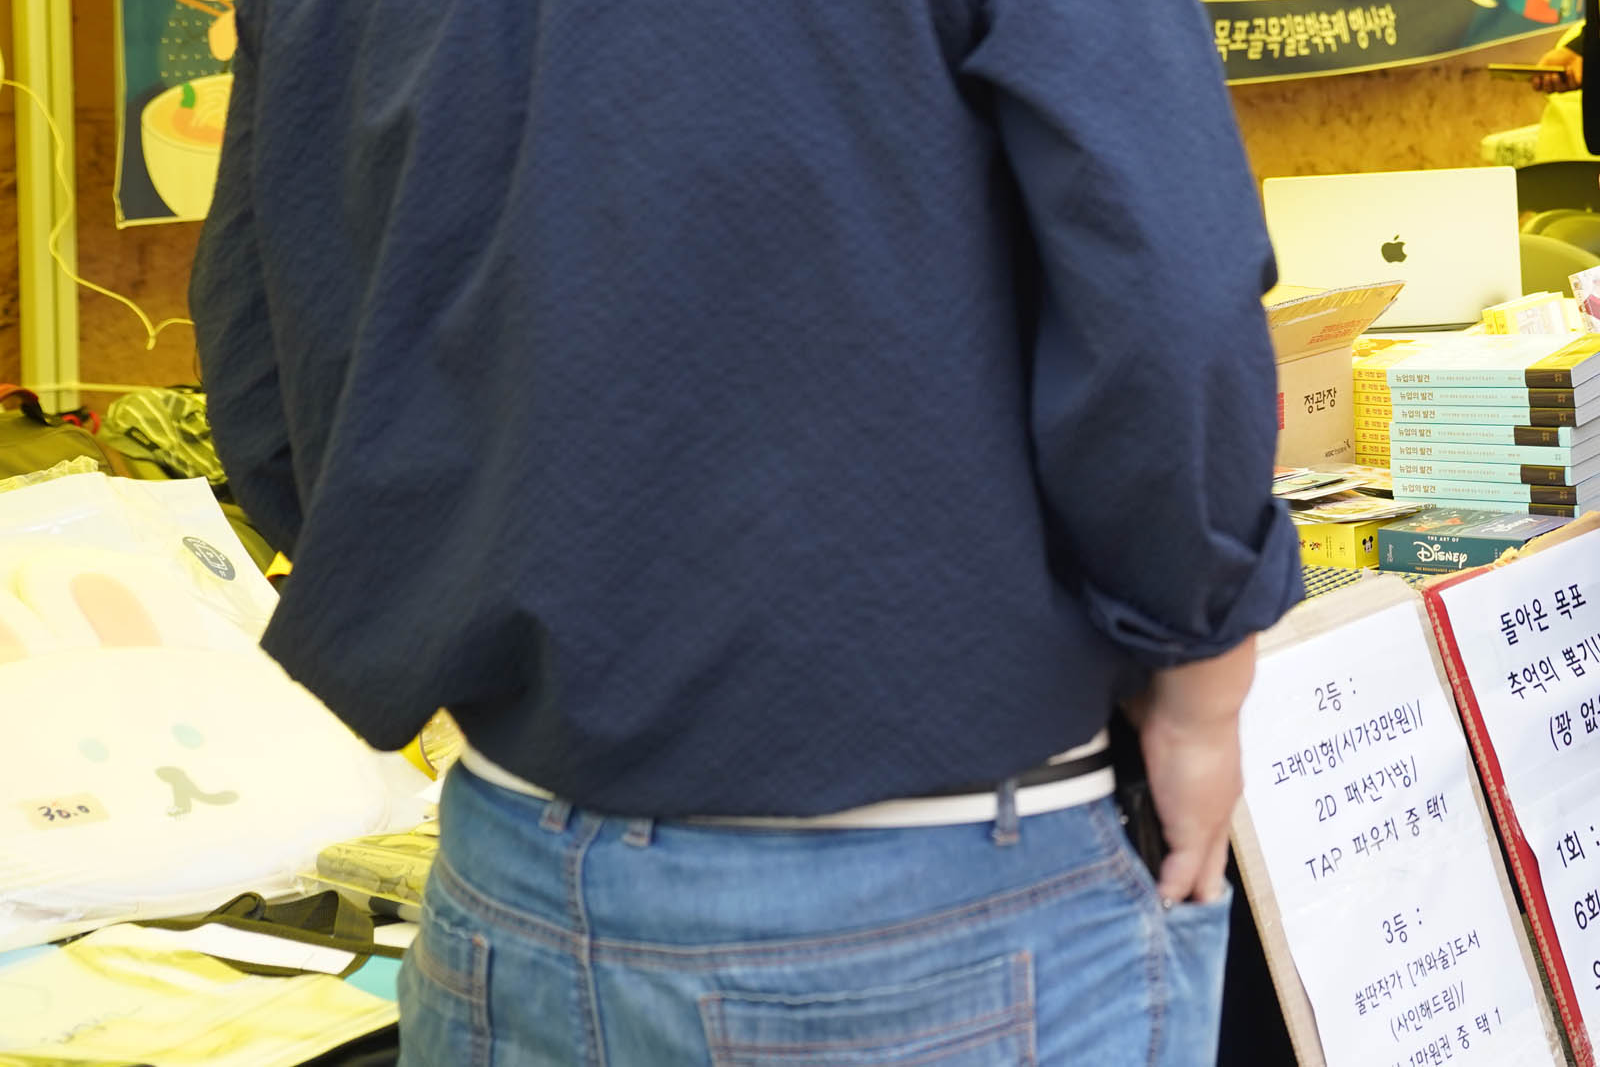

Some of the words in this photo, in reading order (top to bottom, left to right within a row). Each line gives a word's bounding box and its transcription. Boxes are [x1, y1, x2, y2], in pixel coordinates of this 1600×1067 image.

[1303, 386, 1337, 414] 정관장
[1500, 598, 1550, 646] 돌아온
[1554, 584, 1587, 620] 목포
[1314, 682, 1342, 711] 2등
[1507, 656, 1561, 700] 추억의
[1550, 710, 1572, 751] (꽝
[1315, 794, 1337, 822] 2D
[1344, 755, 1417, 804] 패션가방/
[1305, 847, 1343, 881] TAP
[1352, 816, 1399, 856] 파우치
[1406, 807, 1420, 837] 중
[1556, 830, 1586, 868] 1회
[1382, 913, 1408, 944] 3등
[1406, 929, 1480, 987] [개와술]도서
[1390, 980, 1465, 1043] (사인해드림)/
[1457, 1025, 1470, 1050] 중
[1475, 1013, 1491, 1035] 택
[1494, 1006, 1501, 1025] 1
